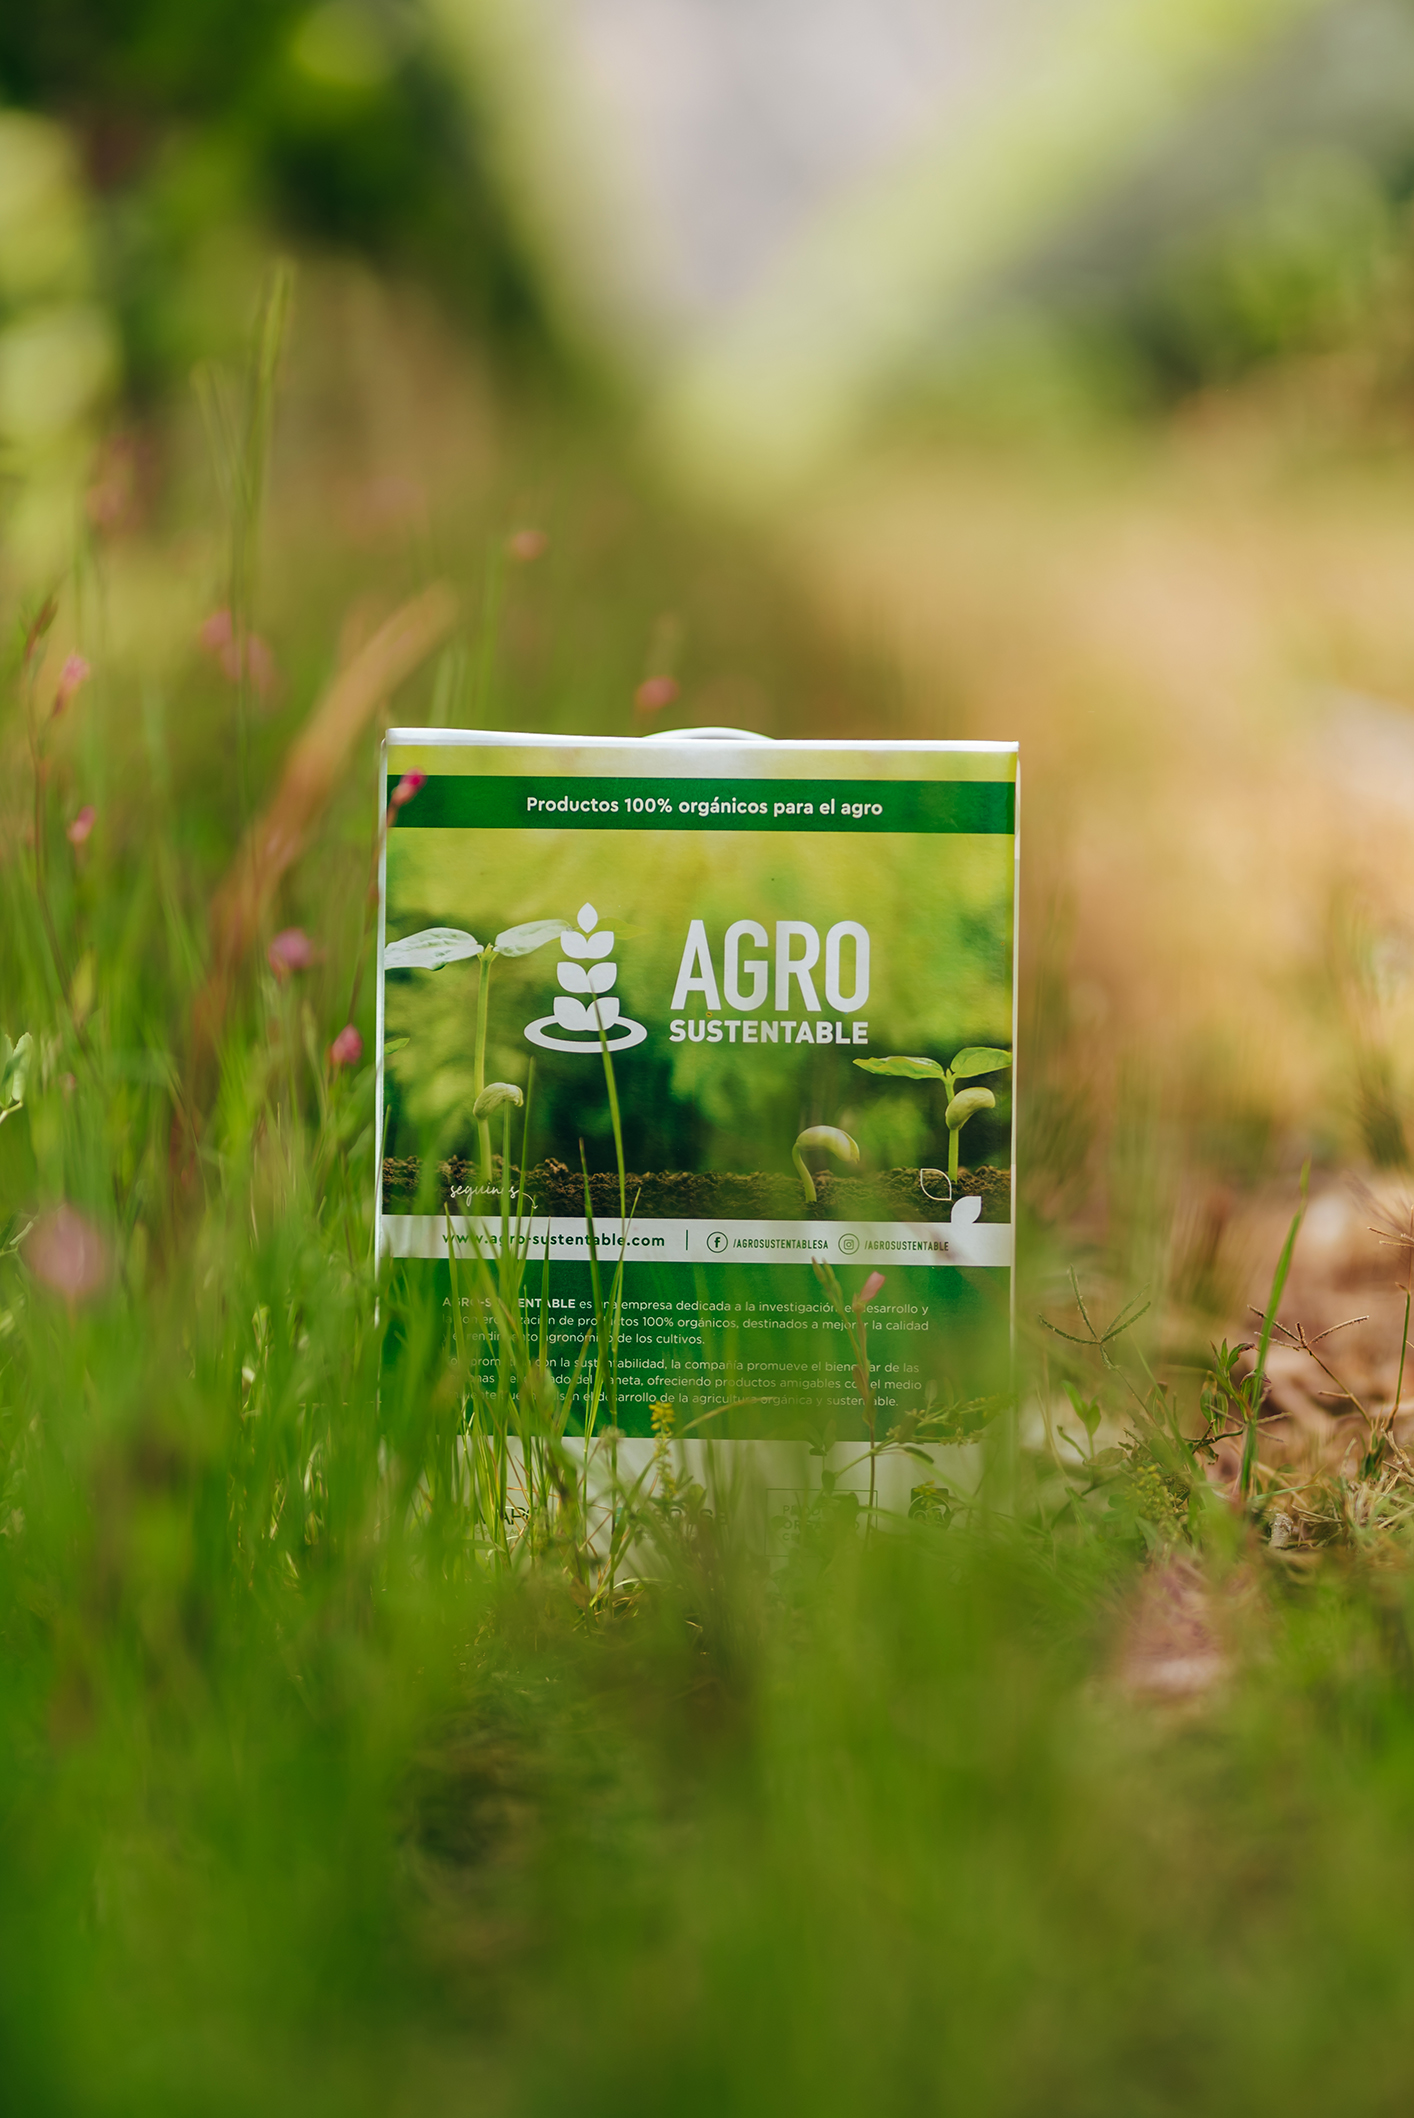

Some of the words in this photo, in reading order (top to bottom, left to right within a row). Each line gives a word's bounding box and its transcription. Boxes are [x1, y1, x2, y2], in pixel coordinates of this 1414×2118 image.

[527, 796, 619, 813] Productos
[624, 797, 673, 813] 100%
[679, 796, 768, 818] orgánicos
[773, 803, 813, 817] para
[819, 799, 835, 814] el
[840, 803, 883, 819] agro
[670, 919, 870, 1013] AGRO
[669, 1019, 869, 1045] SUSTENTABLE
[450, 1182, 520, 1207] seguins
[733, 1238, 829, 1250] /AGROSUSTENTABLESA
[865, 1240, 949, 1251] /AGROSUSTENTABLE
[579, 1300, 593, 1309] es
[621, 1301, 673, 1311] empresa
[676, 1301, 731, 1311] dedicada
[734, 1303, 742, 1311] a
[745, 1302, 756, 1312] la
[922, 1306, 929, 1316] y
[559, 1315, 572, 1326] de
[643, 1317, 674, 1327] 100%
[677, 1318, 739, 1329] orgánicos,
[743, 1319, 808, 1329] destinados
[811, 1321, 819, 1329] a
[822, 1320, 869, 1332] mejorr
[872, 1320, 882, 1330] la
[886, 1321, 929, 1331] calidad
[635, 1334, 653, 1344] los
[656, 1334, 705, 1345] cultivos.
[560, 1357, 571, 1367] la
[671, 1359, 681, 1369] la
[747, 1361, 808, 1373] promueve
[811, 1362, 822, 1371] el
[884, 1363, 899, 1373] de
[903, 1363, 919, 1373] las
[647, 1376, 712, 1387] ofreciendo
[715, 1378, 776, 1388] productos
[780, 1378, 841, 1390] amigables
[870, 1379, 881, 1389] el
[884, 1380, 922, 1390] medio
[660, 1393, 675, 1403] de
[678, 1393, 689, 1403] la
